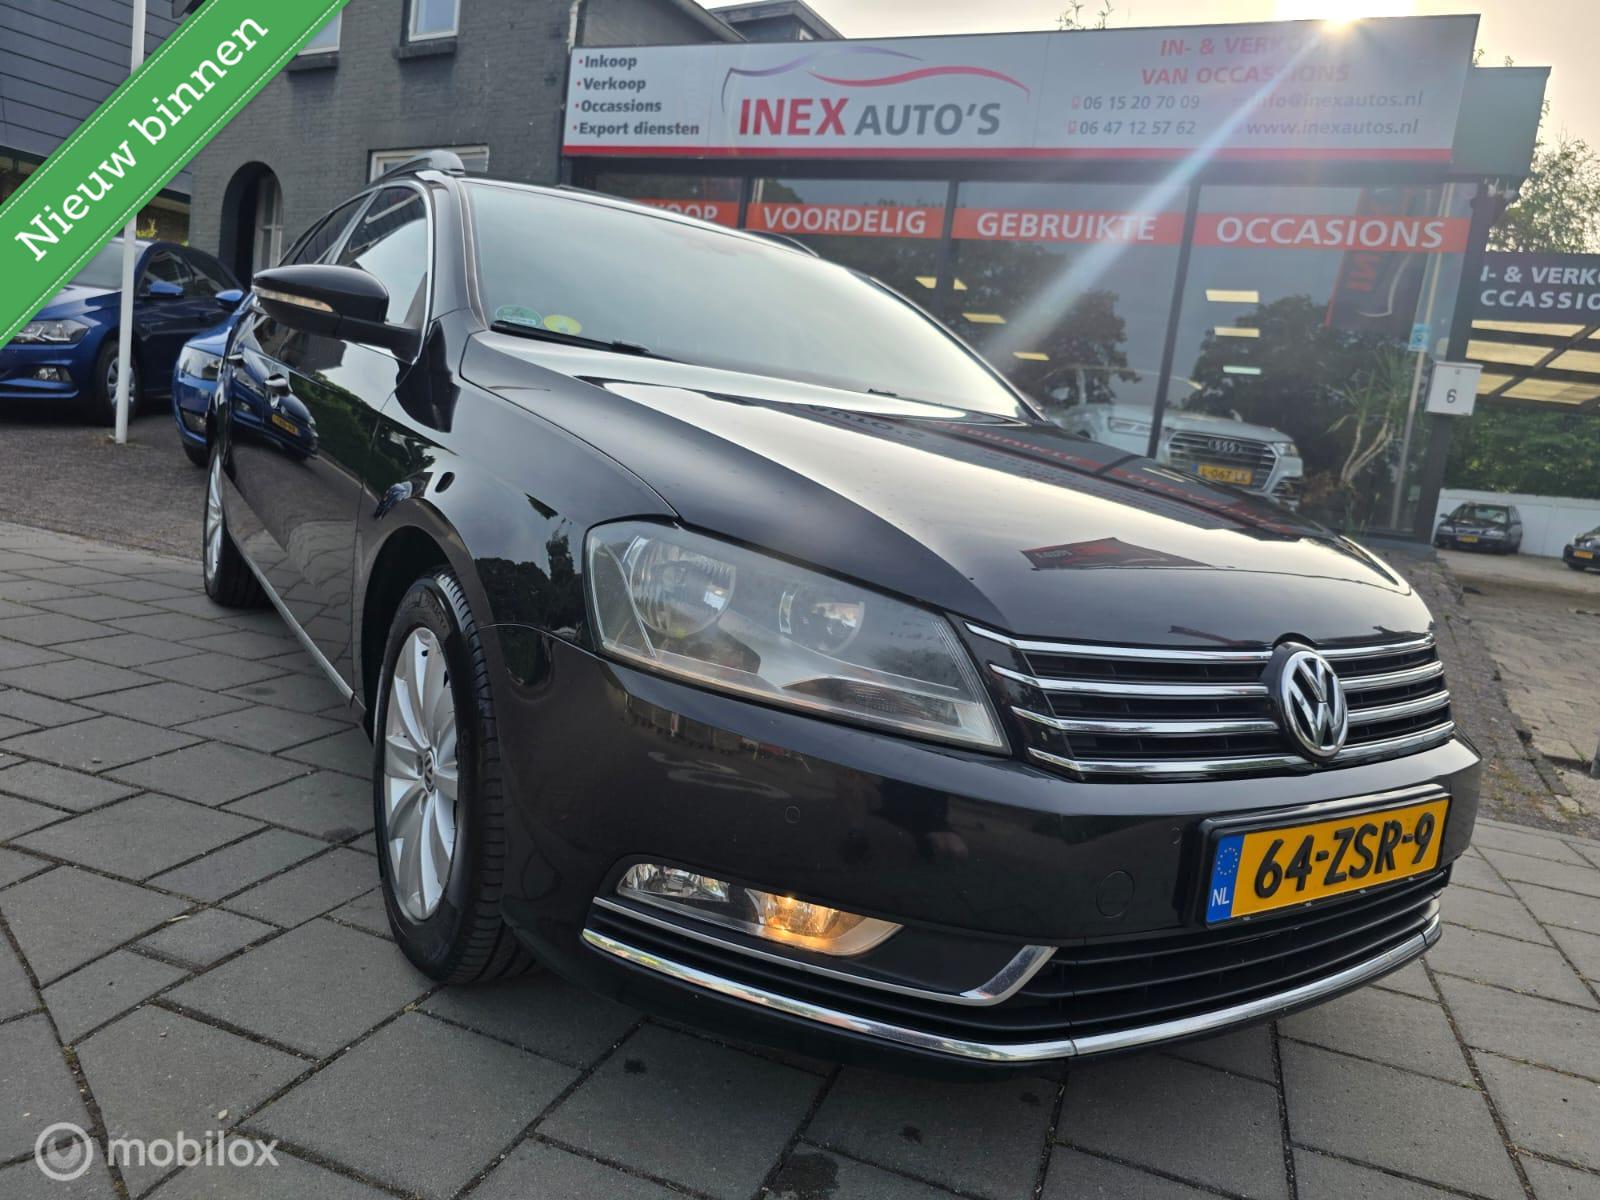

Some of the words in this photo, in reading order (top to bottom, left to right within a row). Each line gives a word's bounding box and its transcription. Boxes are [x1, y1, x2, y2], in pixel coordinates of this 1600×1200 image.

[1160, 39, 1192, 56] IN-
[1200, 38, 1216, 55] &
[584, 54, 638, 71] Inkoop
[1141, 67, 1189, 85] VAN
[1196, 65, 1350, 84] OCCASIONS
[583, 76, 647, 93] Verkoop
[581, 99, 662, 113] Occassions
[1083, 96, 1102, 110] 06
[1108, 96, 1127, 110] 15
[1130, 96, 1151, 110] 20
[1155, 95, 1176, 109] 70
[1179, 95, 1201, 109] 09
[1257, 90, 1424, 108] nfo@inexautos.nl
[738, 97, 849, 136] INEX
[853, 102, 1001, 136] AUTO'S
[579, 122, 629, 138] Export
[633, 121, 700, 136] diensten
[1079, 121, 1099, 135] 06
[1103, 121, 1123, 135] 47
[1129, 121, 1147, 135] 12
[1151, 121, 1172, 135] 57
[1175, 121, 1197, 135] 62
[1247, 118, 1419, 136] www.inexautos.nl
[763, 206, 927, 235] VOORDELIG
[976, 211, 1157, 241] GEBRUIKTE
[1216, 217, 1445, 249] OCCASIONS
[1503, 266, 1522, 283] &
[1531, 266, 1600, 286] VERK
[1446, 388, 1457, 404] 6
[1254, 812, 1436, 899] 64-ZSR-9
[1211, 887, 1230, 908] NL
